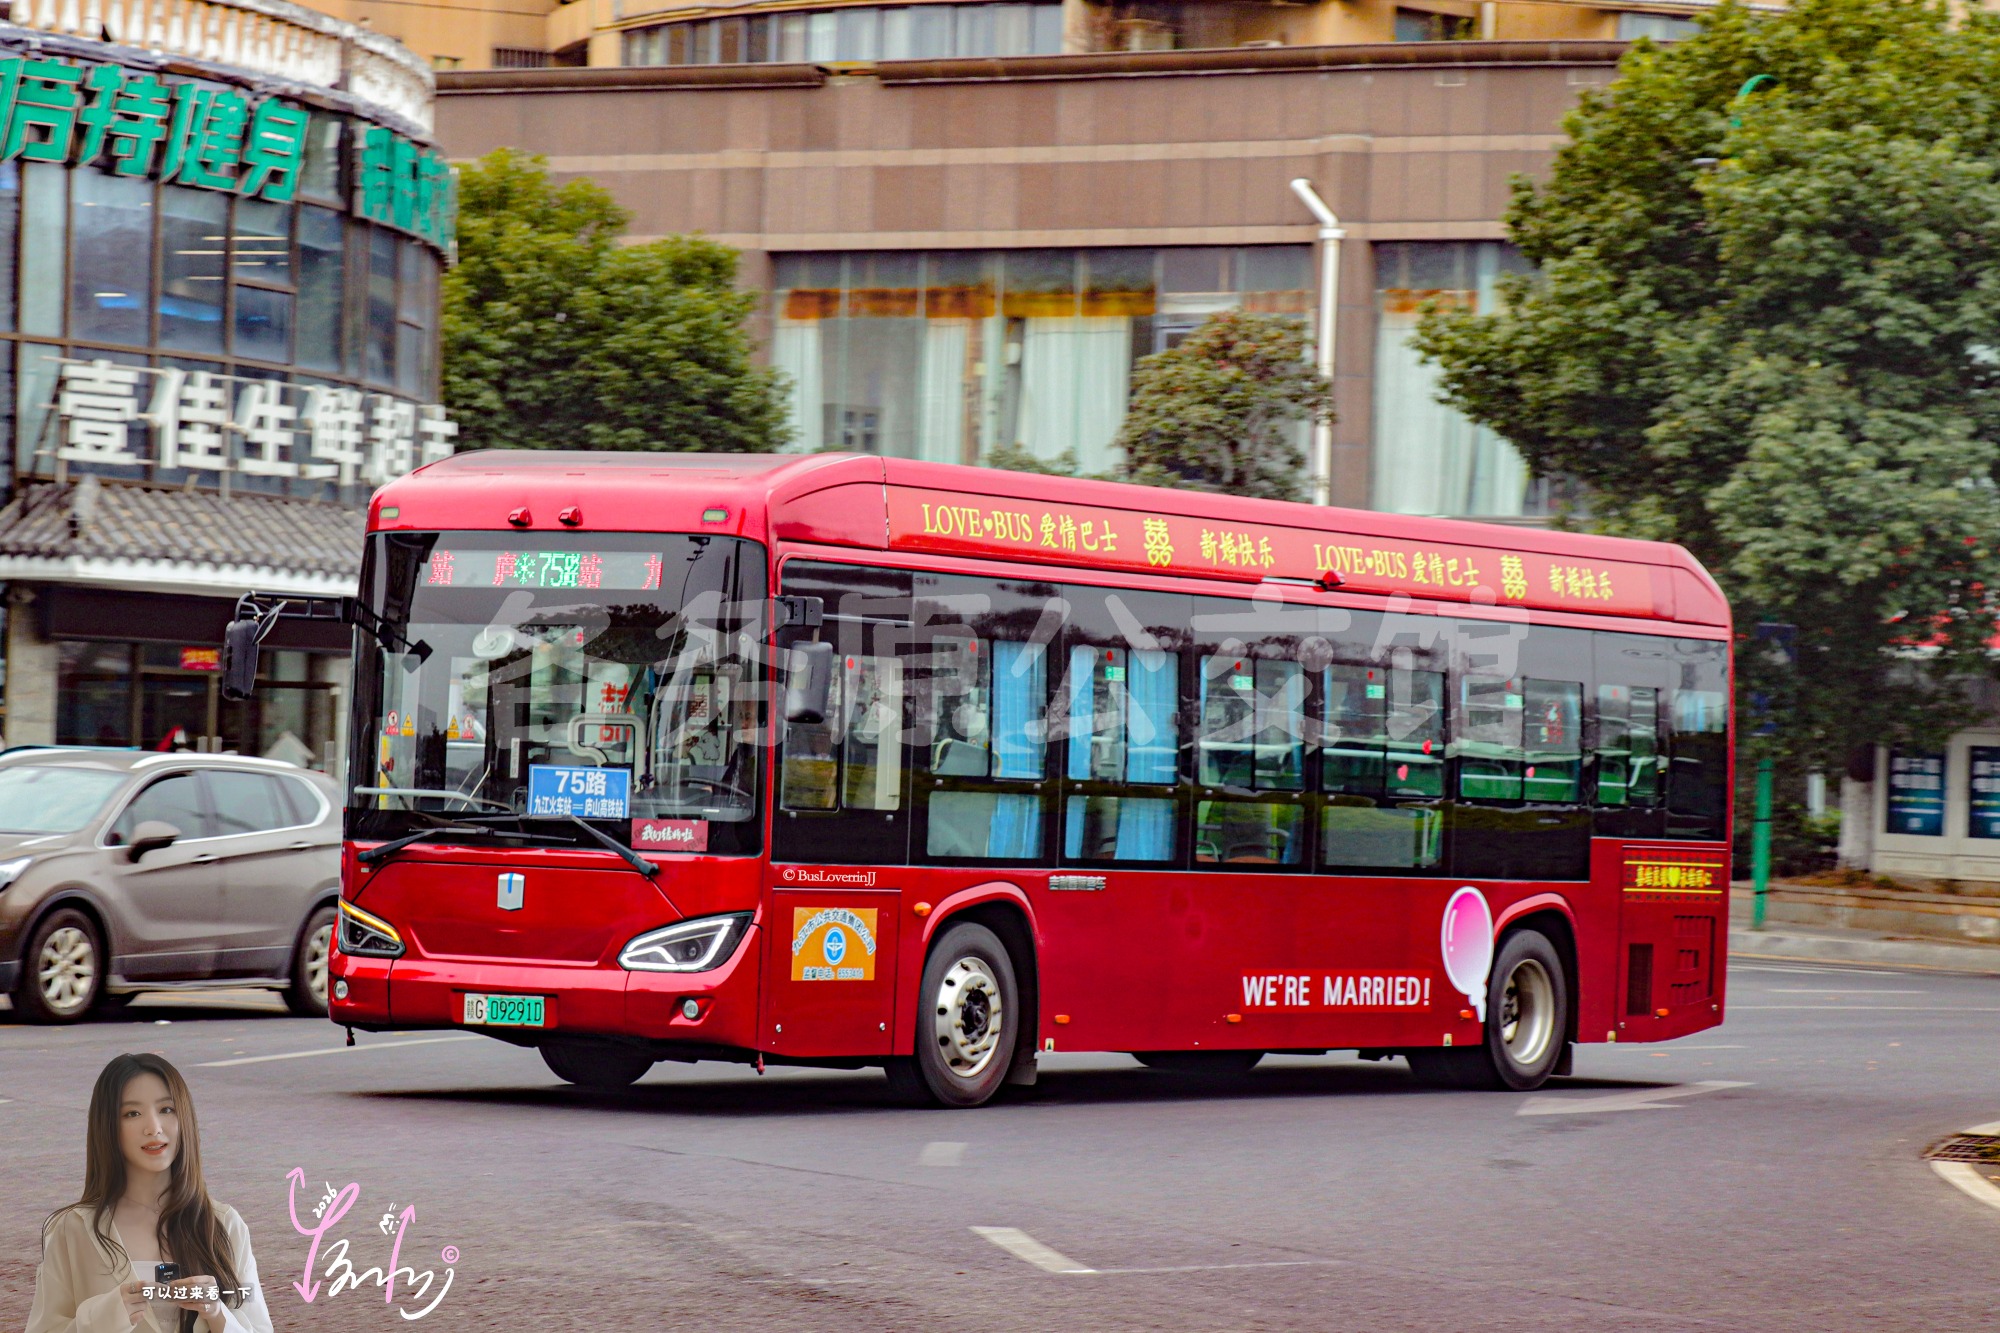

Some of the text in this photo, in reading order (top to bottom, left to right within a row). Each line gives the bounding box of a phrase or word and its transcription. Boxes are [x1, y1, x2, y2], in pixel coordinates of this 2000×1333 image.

[1039, 513, 1118, 552] 爱情巴士
[1200, 528, 1275, 569] 新婚快乐
[1412, 552, 1480, 587] 爱情巴士
[1548, 564, 1614, 601] 新婚快乐
[554, 770, 607, 797] 75路
[1242, 974, 1431, 1007] WE'RE MARRIED!
